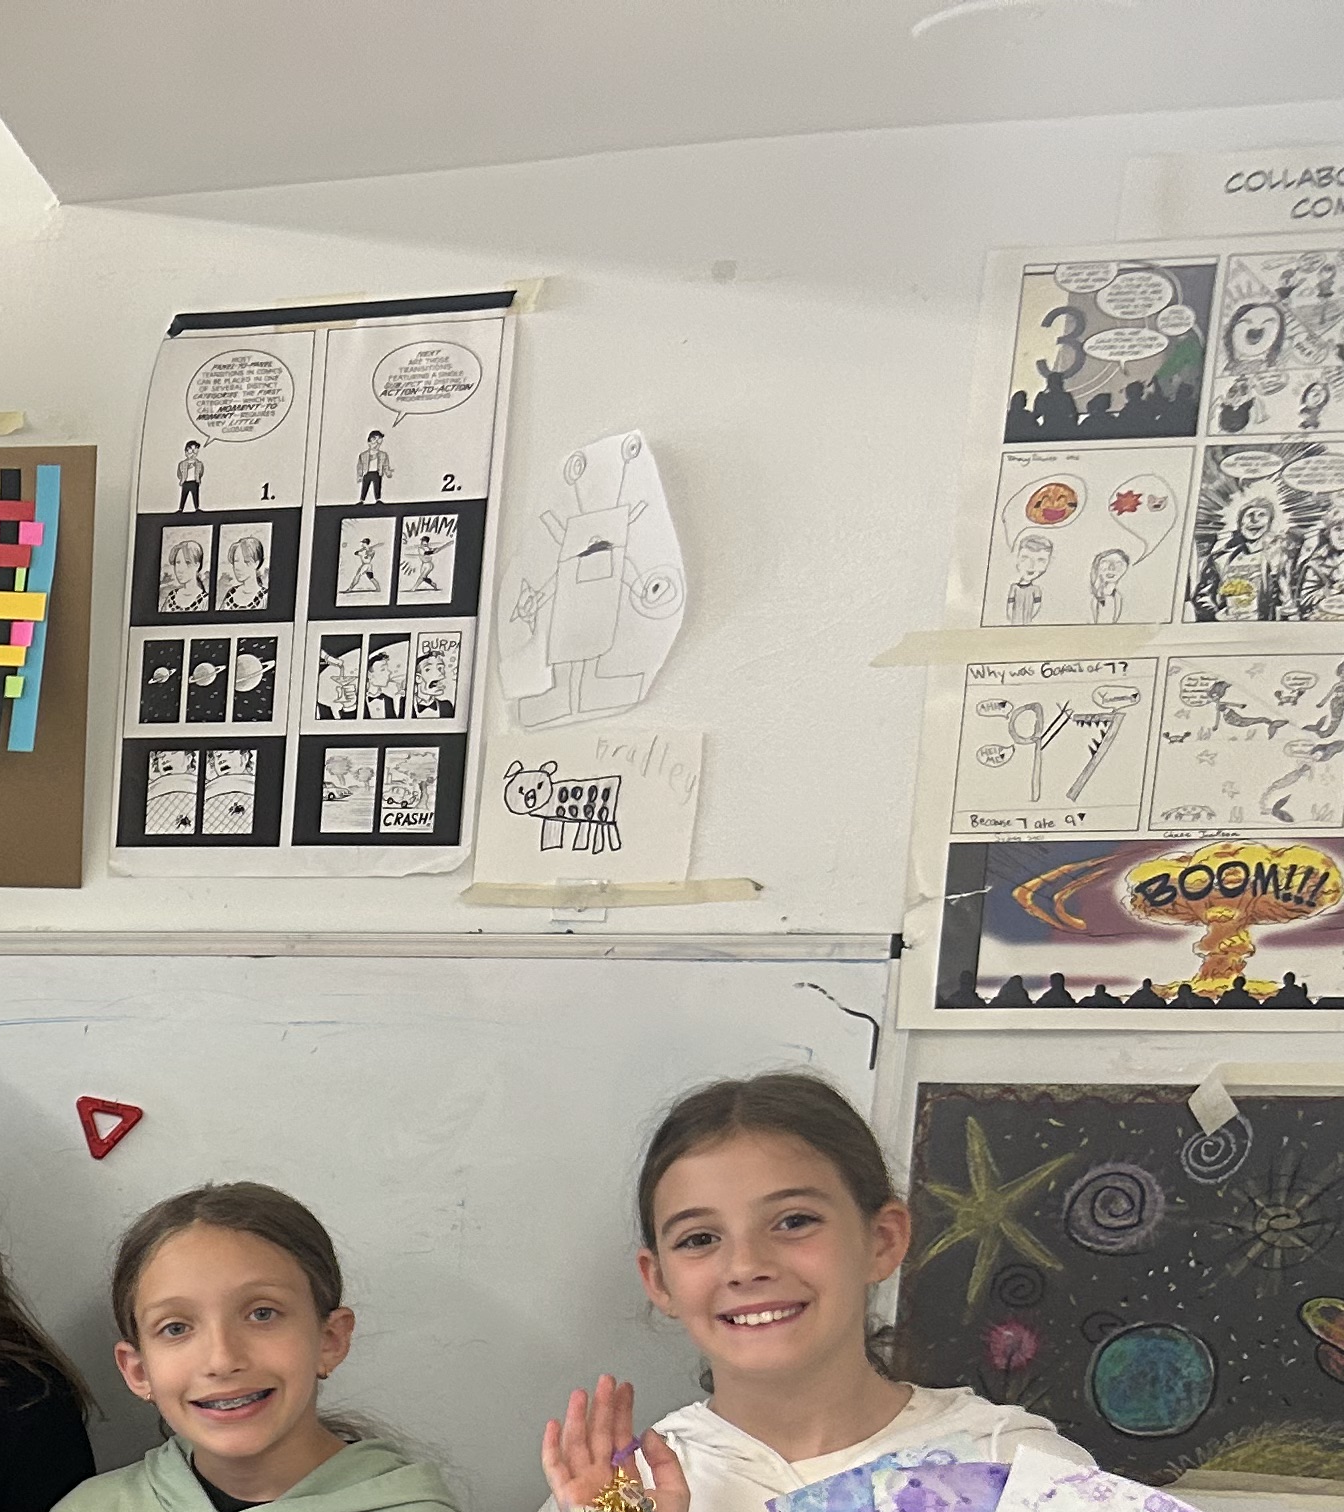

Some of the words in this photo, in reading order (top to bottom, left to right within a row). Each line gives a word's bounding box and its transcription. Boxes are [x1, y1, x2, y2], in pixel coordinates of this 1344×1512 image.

[380, 383, 474, 397] ACTION-TO-ACTION
[260, 482, 276, 500] 1.
[441, 474, 462, 492] 2.
[405, 516, 458, 539] WHAM!
[970, 665, 1005, 684] Why
[1009, 667, 1035, 677] was
[1040, 663, 1052, 679] 6
[383, 809, 434, 828] CRASH!
[970, 814, 1012, 828] Because
[1034, 818, 1055, 828] ate
[1135, 860, 1330, 907] BOOM!!!
